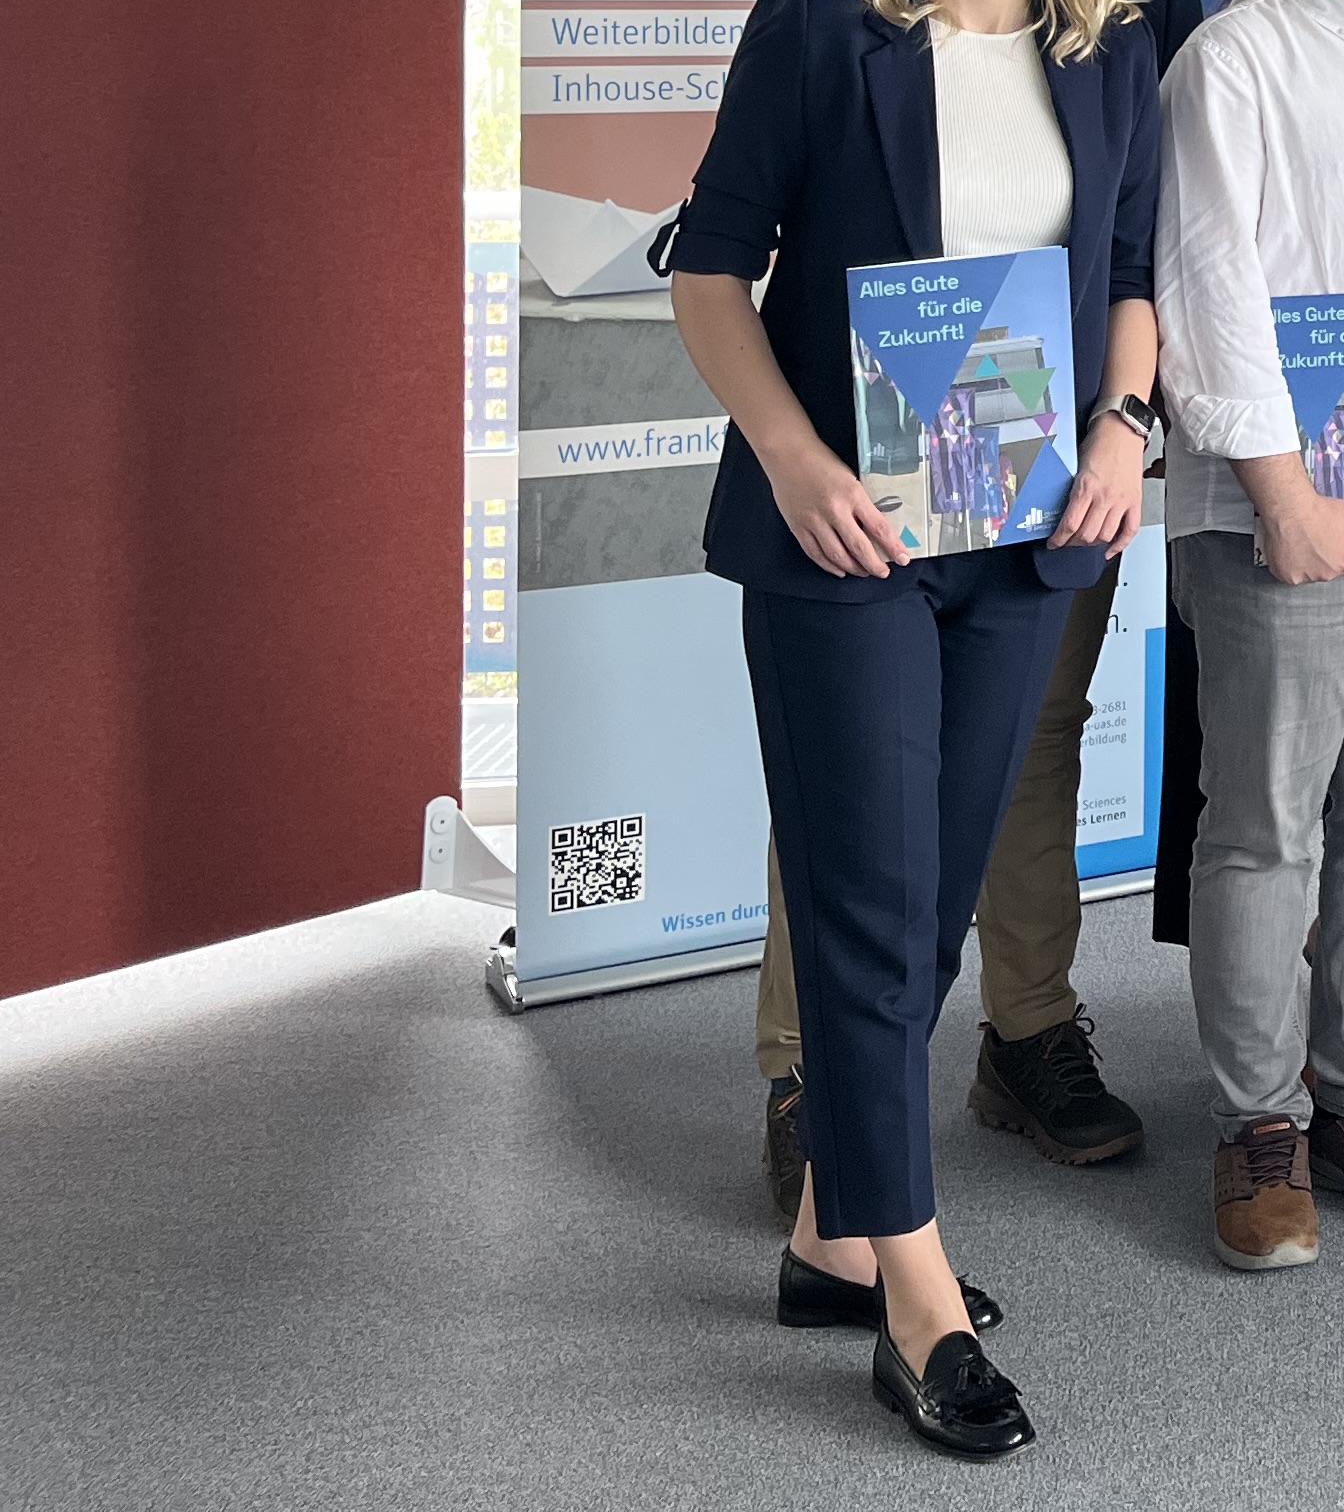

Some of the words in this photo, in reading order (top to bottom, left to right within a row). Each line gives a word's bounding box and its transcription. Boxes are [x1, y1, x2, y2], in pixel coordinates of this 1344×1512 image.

[551, 16, 744, 45] Weiterbilden
[860, 280, 907, 298] Alles
[911, 275, 959, 293] Gute
[917, 300, 948, 318] für
[952, 297, 983, 315] die
[1273, 308, 1301, 323] lles
[878, 323, 965, 348] Zukunft!
[1309, 329, 1336, 344] für
[1082, 795, 1127, 811] Sciences
[1090, 811, 1127, 825] Lernen
[661, 911, 726, 932] Wissen
